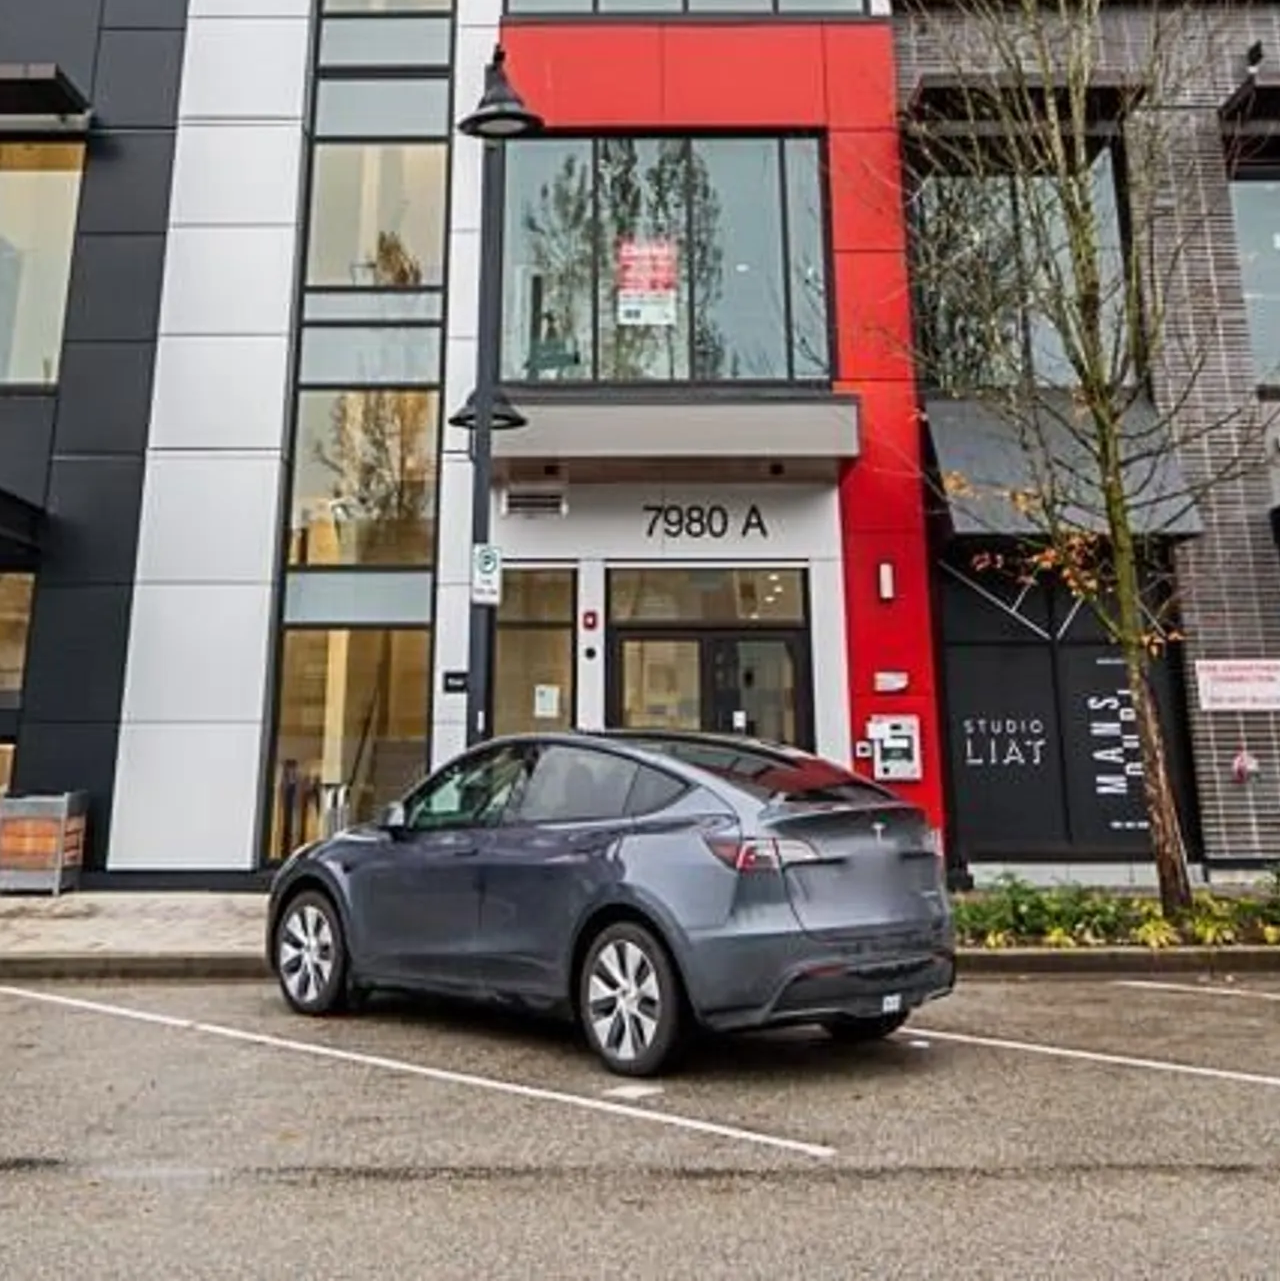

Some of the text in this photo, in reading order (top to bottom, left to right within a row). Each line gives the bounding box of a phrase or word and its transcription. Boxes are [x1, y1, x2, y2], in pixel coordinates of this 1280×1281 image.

[643, 504, 768, 537] 7980 A
[963, 719, 1044, 735] STUDIO
[966, 738, 1047, 765] LIAT
